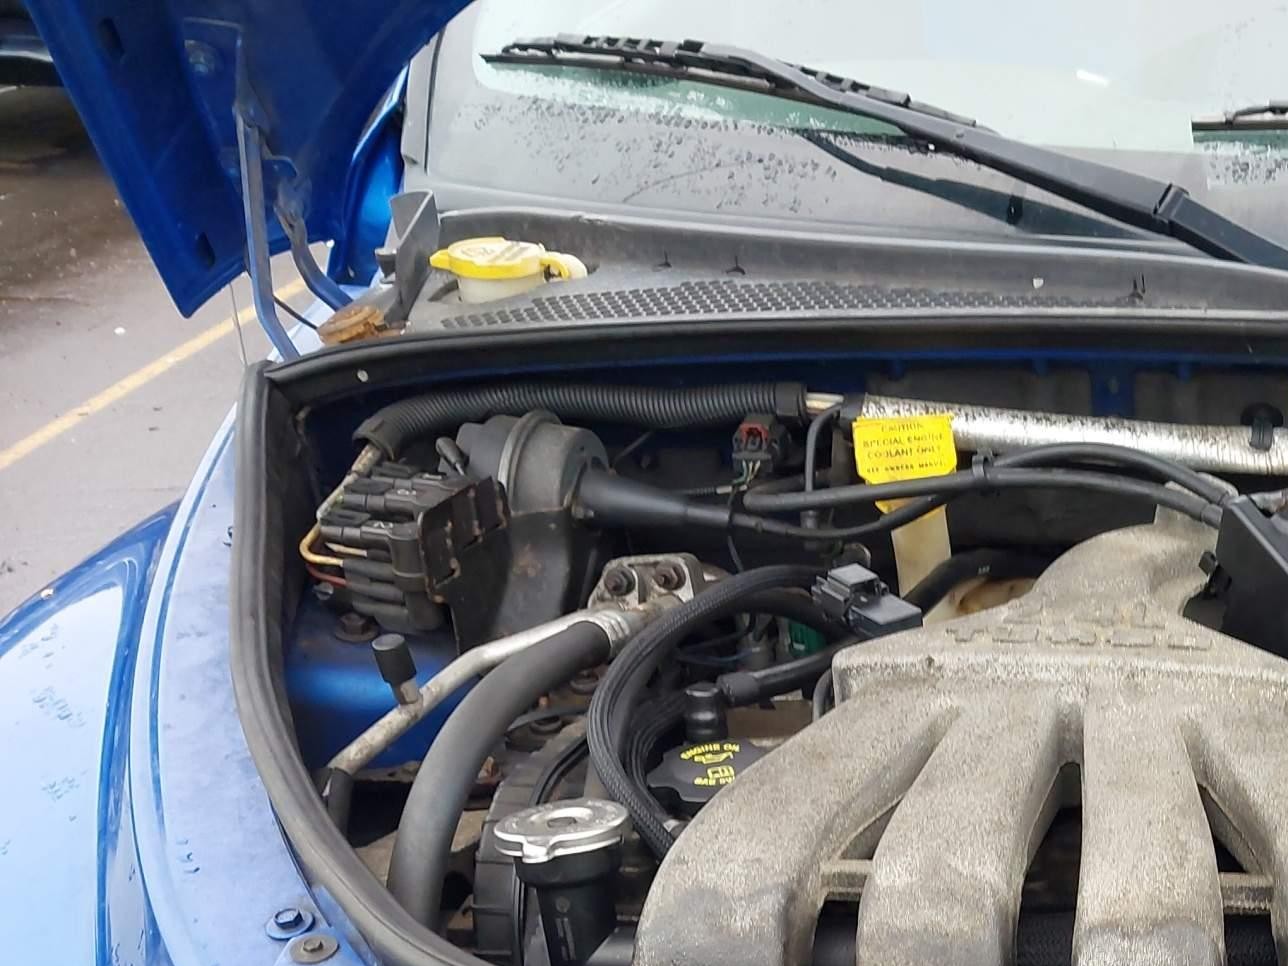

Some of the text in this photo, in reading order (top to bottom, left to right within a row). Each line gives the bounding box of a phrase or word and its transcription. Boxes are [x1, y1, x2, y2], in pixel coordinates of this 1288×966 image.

[880, 421, 925, 433] CAUTION
[862, 432, 944, 448] SPECIAL ENGINE
[867, 448, 913, 460] COOLANT
[680, 743, 721, 760] ENGINE
